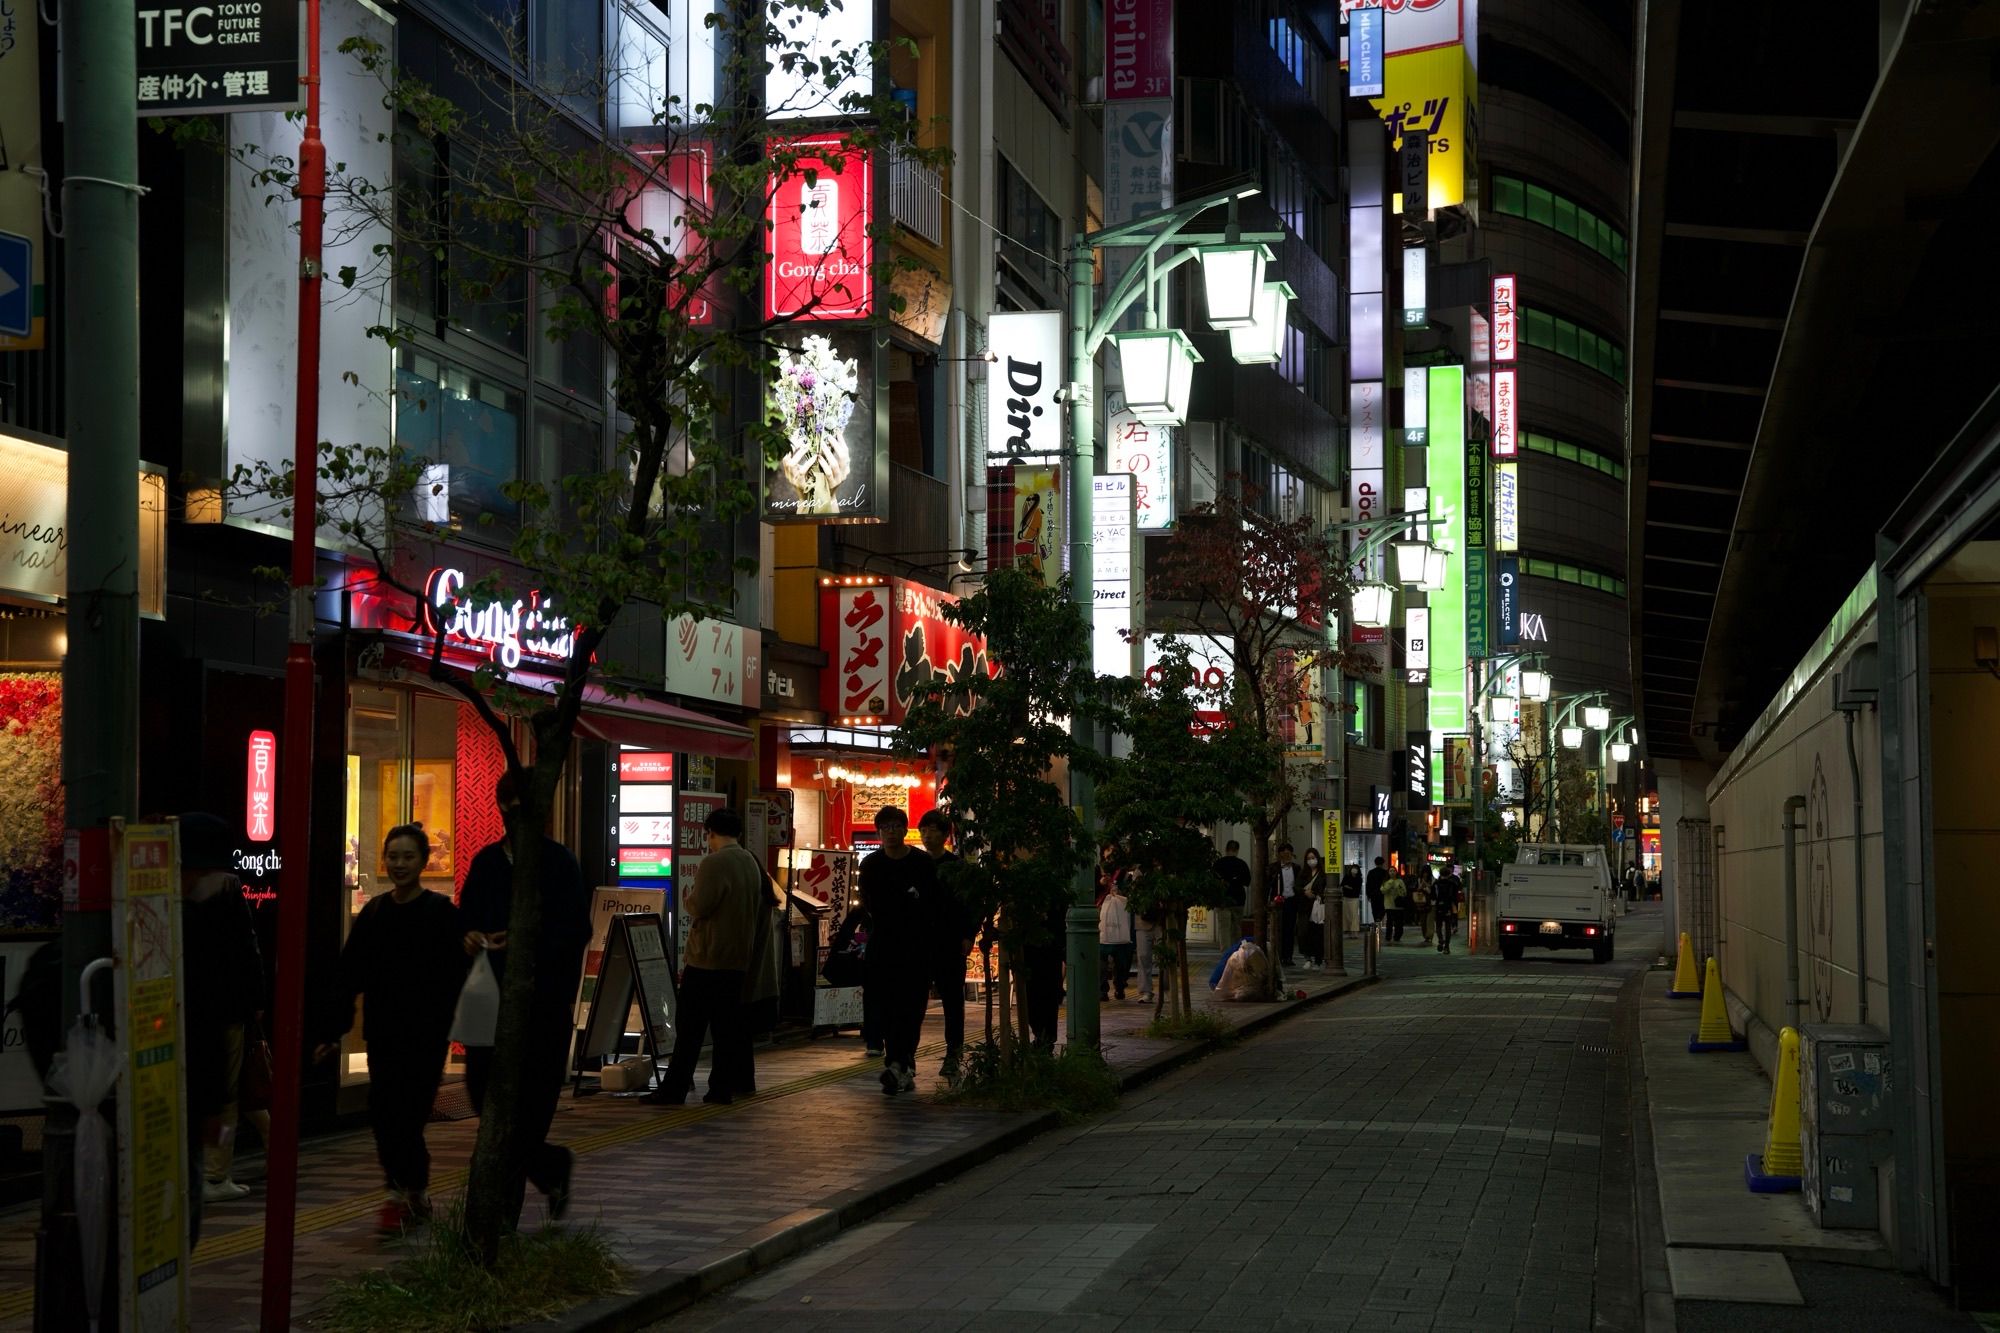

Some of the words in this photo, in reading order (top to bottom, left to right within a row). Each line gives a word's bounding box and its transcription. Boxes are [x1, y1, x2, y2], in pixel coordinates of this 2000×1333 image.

[217, 2, 261, 15] TOKYO
[138, 6, 214, 48] TFC
[217, 17, 261, 30] FUTURE
[217, 32, 261, 45] CREATE
[1143, 76, 1168, 94] 3F
[778, 261, 825, 282] Gong
[829, 259, 860, 276] cha
[1406, 310, 1424, 323] 5F
[1497, 286, 1510, 351] カラオケ
[1007, 355, 1043, 465] Dire
[1362, 386, 1373, 457] ワンステップ
[1406, 430, 1425, 443] 4F
[830, 483, 866, 509] nail
[1107, 528, 1126, 537] YAC
[845, 590, 884, 713] ラーメン
[746, 656, 758, 679] 6F
[1408, 670, 1427, 683] 2F
[611, 763, 618, 772] 8
[252, 737, 272, 835] 貢茶
[611, 795, 617, 803] 7
[1377, 792, 1390, 810] アイ
[611, 826, 617, 835] 6
[1328, 822, 1338, 866] とびだし注意
[610, 859, 617, 867] 5
[602, 899, 652, 913] iPhone
